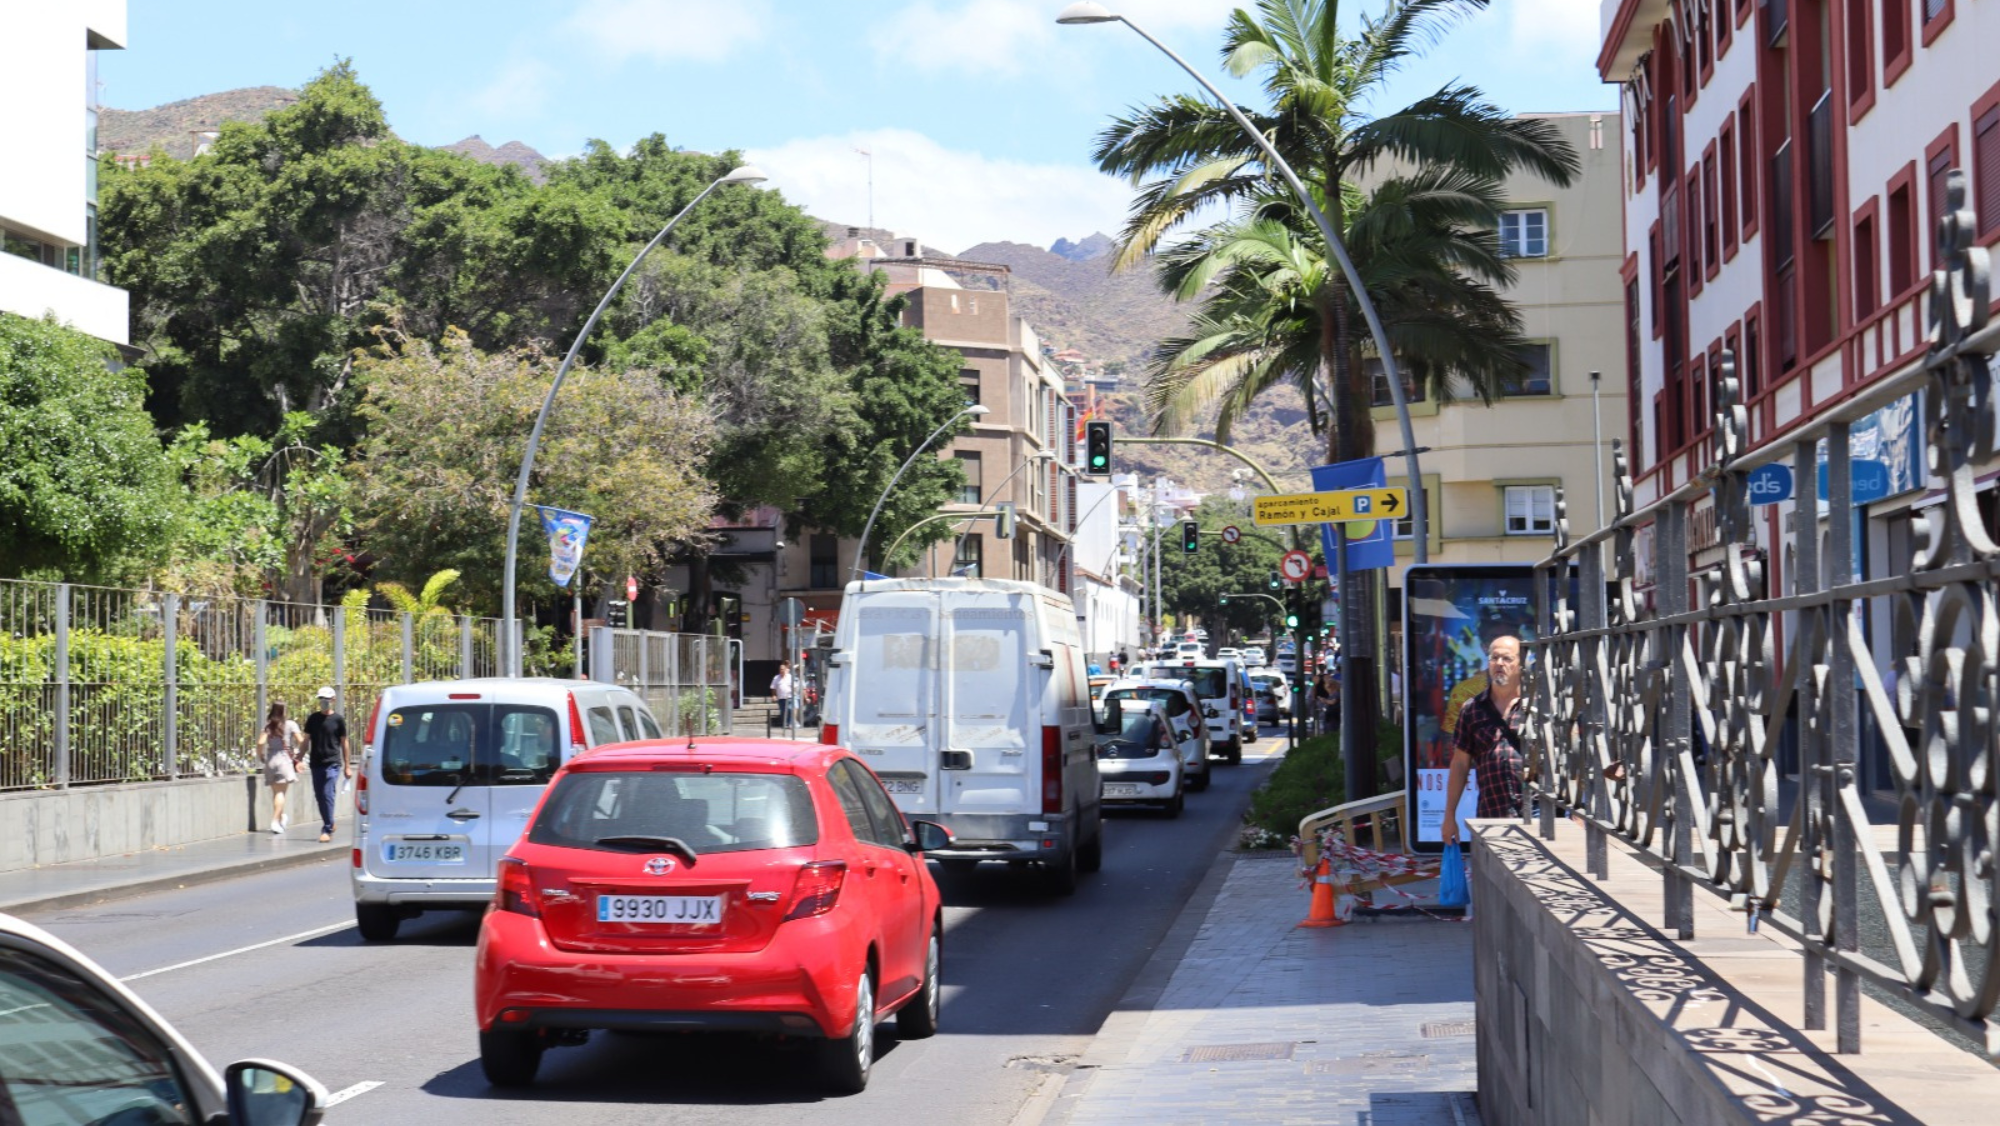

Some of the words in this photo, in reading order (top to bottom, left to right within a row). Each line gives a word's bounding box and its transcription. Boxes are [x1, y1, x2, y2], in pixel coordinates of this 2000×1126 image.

[1257, 496, 1319, 508] aparcamiento
[1357, 497, 1368, 511] P
[1259, 507, 1295, 520] Ramón
[1300, 509, 1306, 519] y
[1312, 506, 1340, 518] Cajal
[897, 780, 920, 792] BNG
[397, 845, 431, 860] 3746
[434, 845, 462, 859] KBR
[613, 899, 667, 919] 9930
[674, 897, 716, 920] JJX
